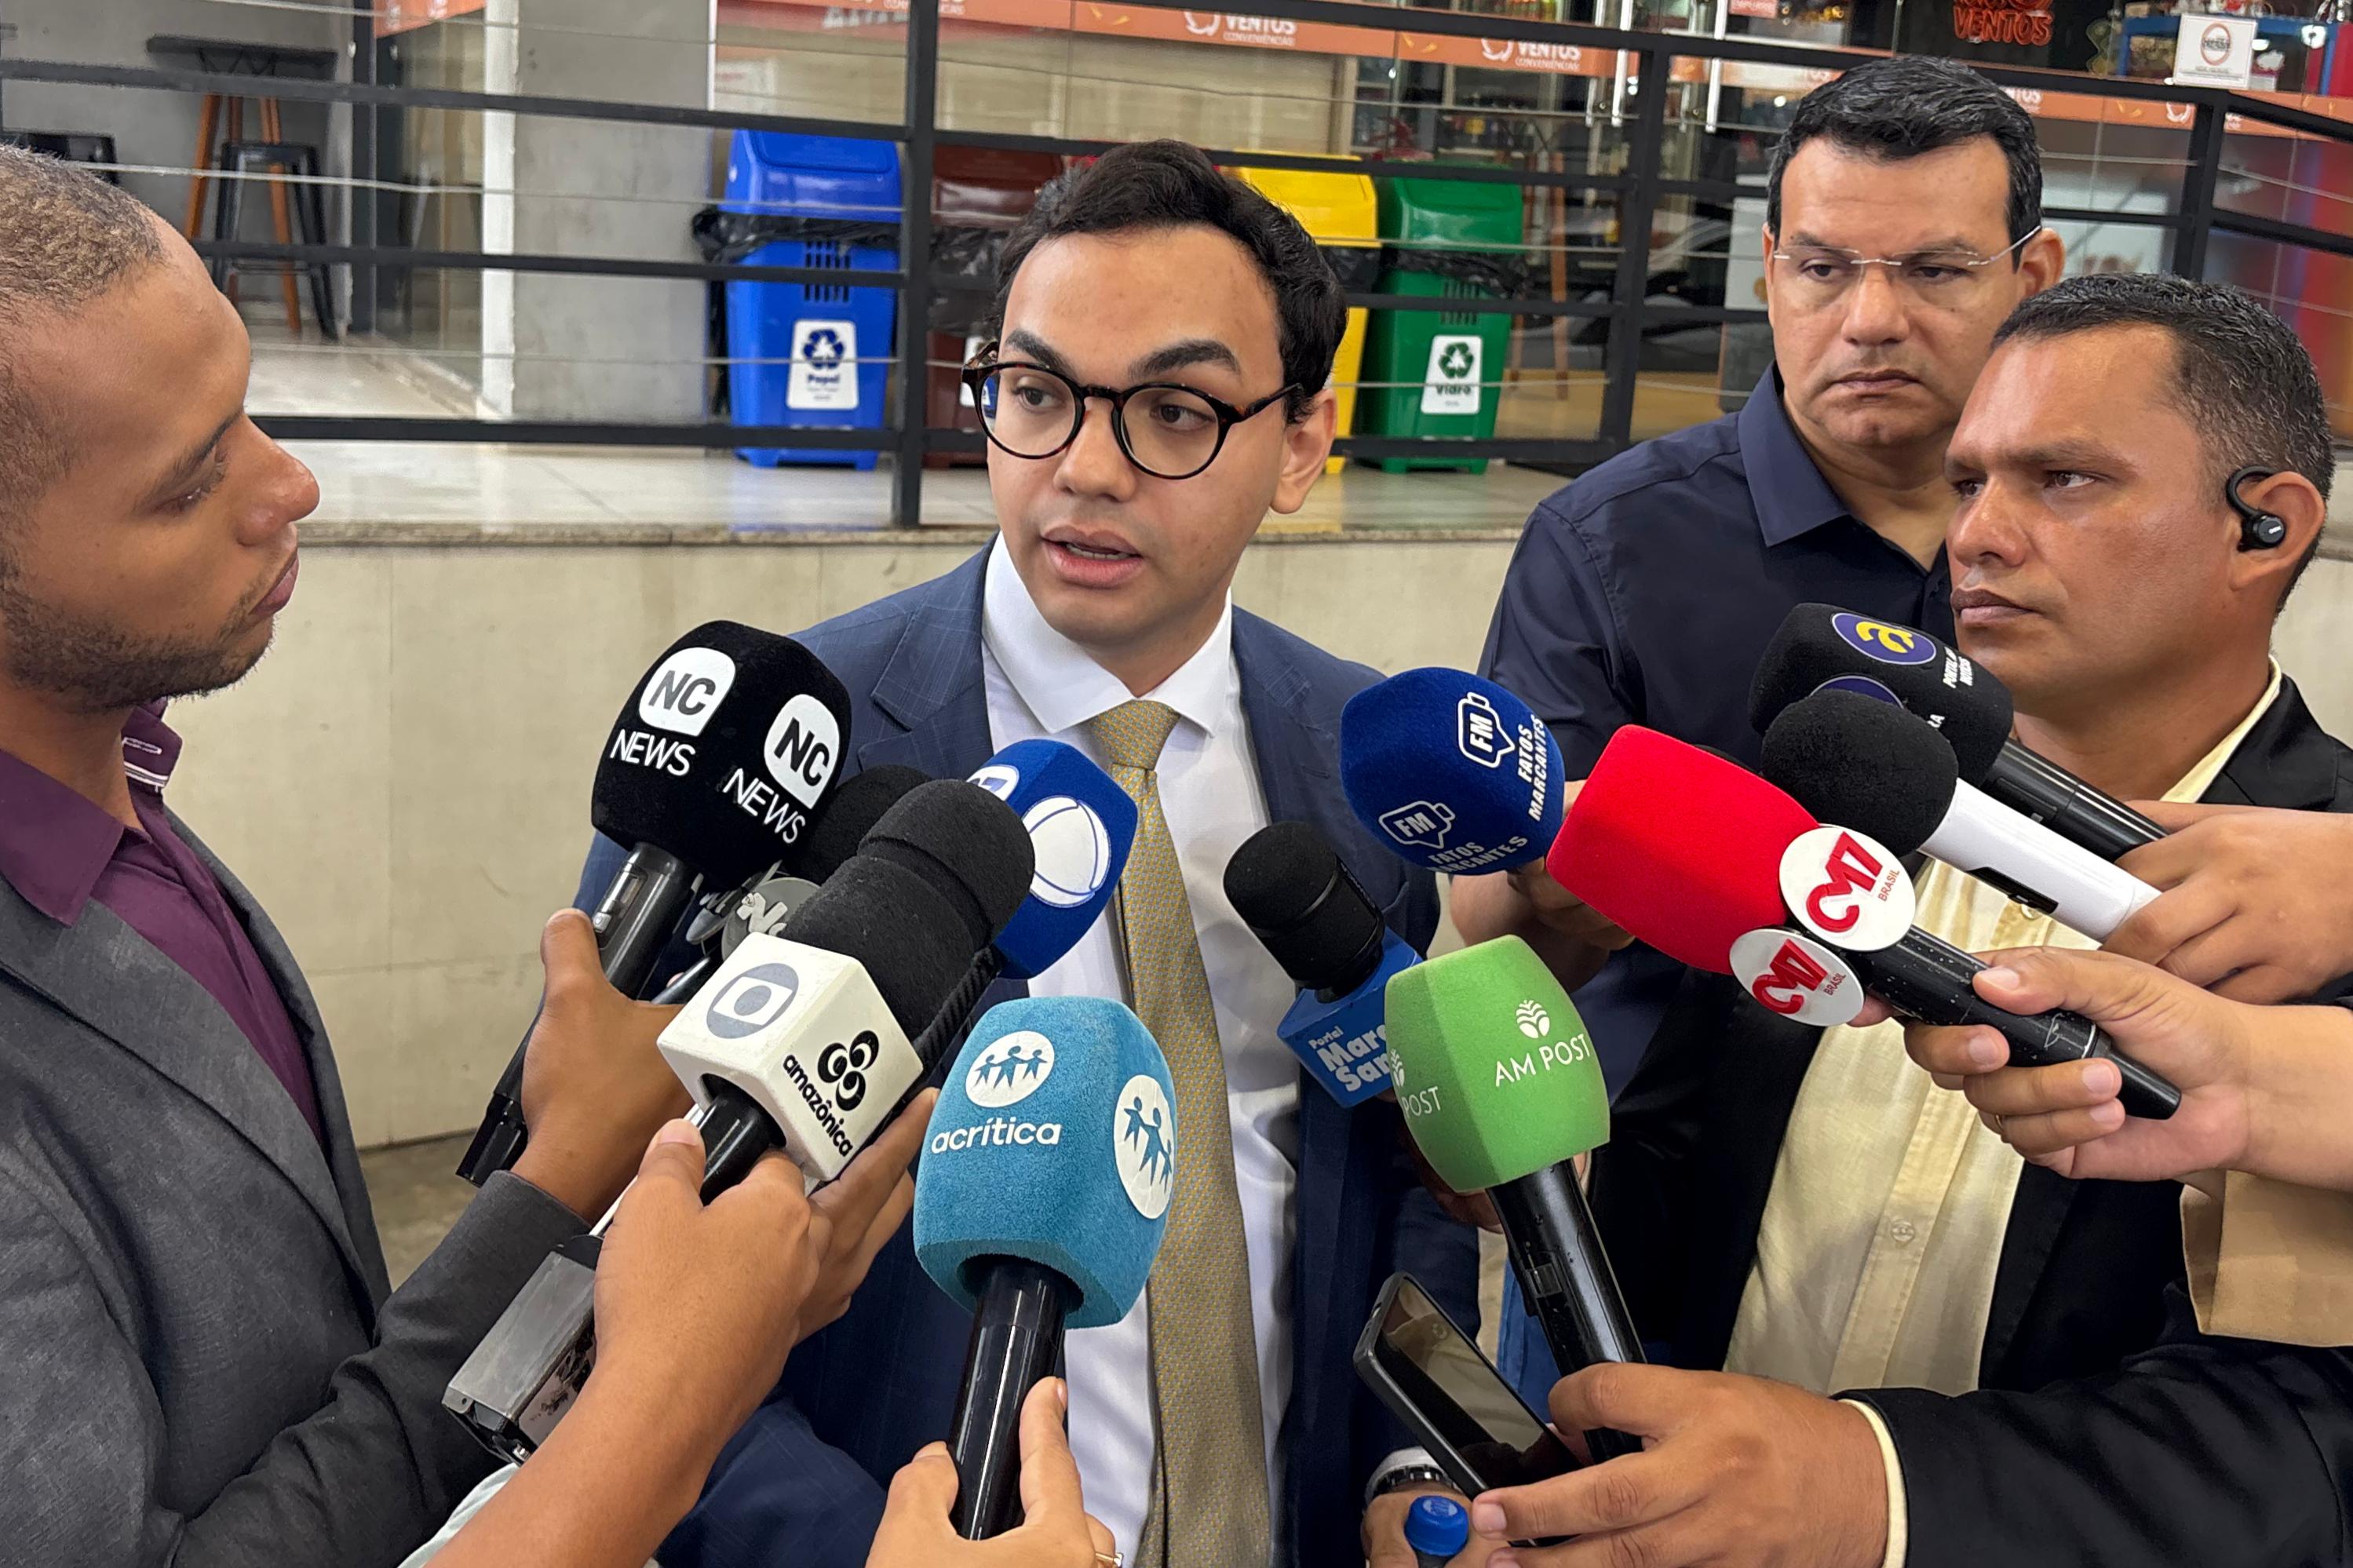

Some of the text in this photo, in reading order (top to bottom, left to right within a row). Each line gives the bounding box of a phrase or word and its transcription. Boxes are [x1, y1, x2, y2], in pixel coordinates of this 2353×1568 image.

[1226, 15, 1297, 35] VENTOS
[1954, 6, 2053, 46] VENTOS
[1518, 41, 1582, 61] VENTOS
[1435, 383, 1472, 396] Vidro
[648, 669, 716, 716] NC
[773, 717, 830, 787] NC
[1469, 712, 1494, 753] FM
[610, 728, 696, 777] NEWS
[1518, 724, 1533, 783] FATOS
[1527, 714, 1548, 822] MARCANTES
[722, 768, 806, 844] NEWS
[1393, 811, 1438, 838] FM
[1428, 841, 1485, 864] FATOS
[1877, 869, 1900, 903] BRASIL
[1822, 972, 1847, 996] BRASIL
[1308, 1026, 1344, 1049] Portal
[1495, 1034, 1591, 1087] AM POST
[783, 1054, 853, 1158] amazônica
[1401, 1085, 1441, 1119] POST
[931, 1116, 1062, 1154] acrítica
